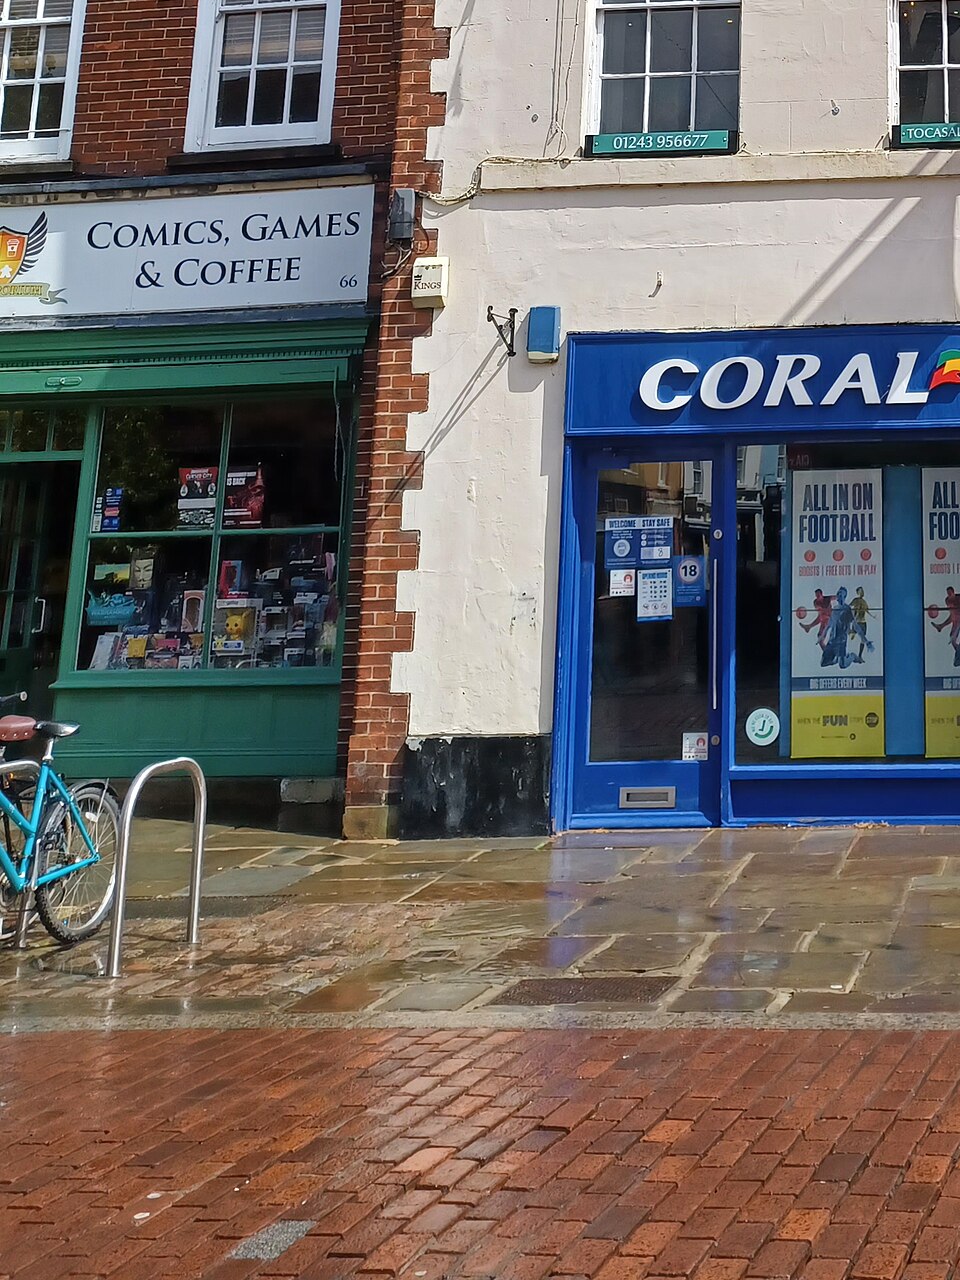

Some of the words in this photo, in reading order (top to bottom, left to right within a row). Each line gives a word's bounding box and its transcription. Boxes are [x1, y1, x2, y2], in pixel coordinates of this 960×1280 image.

[613, 135, 653, 150] 01243
[656, 134, 709, 148] 956677
[87, 219, 230, 251] COMICS,
[241, 211, 361, 241] GAMES
[135, 260, 165, 289] &
[173, 256, 301, 287] COFFEE
[339, 273, 358, 289] 66
[413, 281, 442, 290] KINGS
[0, 285, 43, 297] ORIUM
[638, 351, 930, 411] CORAL
[802, 484, 829, 511] ALL
[832, 483, 849, 510] IN
[852, 482, 873, 510] ON
[932, 481, 960, 509] ALL
[608, 519, 637, 529] WELCOME
[642, 519, 655, 528] STAY
[656, 518, 670, 527] SAFE
[799, 512, 877, 543] FOOTBALL
[681, 565, 698, 577] 18
[825, 565, 838, 576] FREE
[822, 714, 848, 727] FUN
